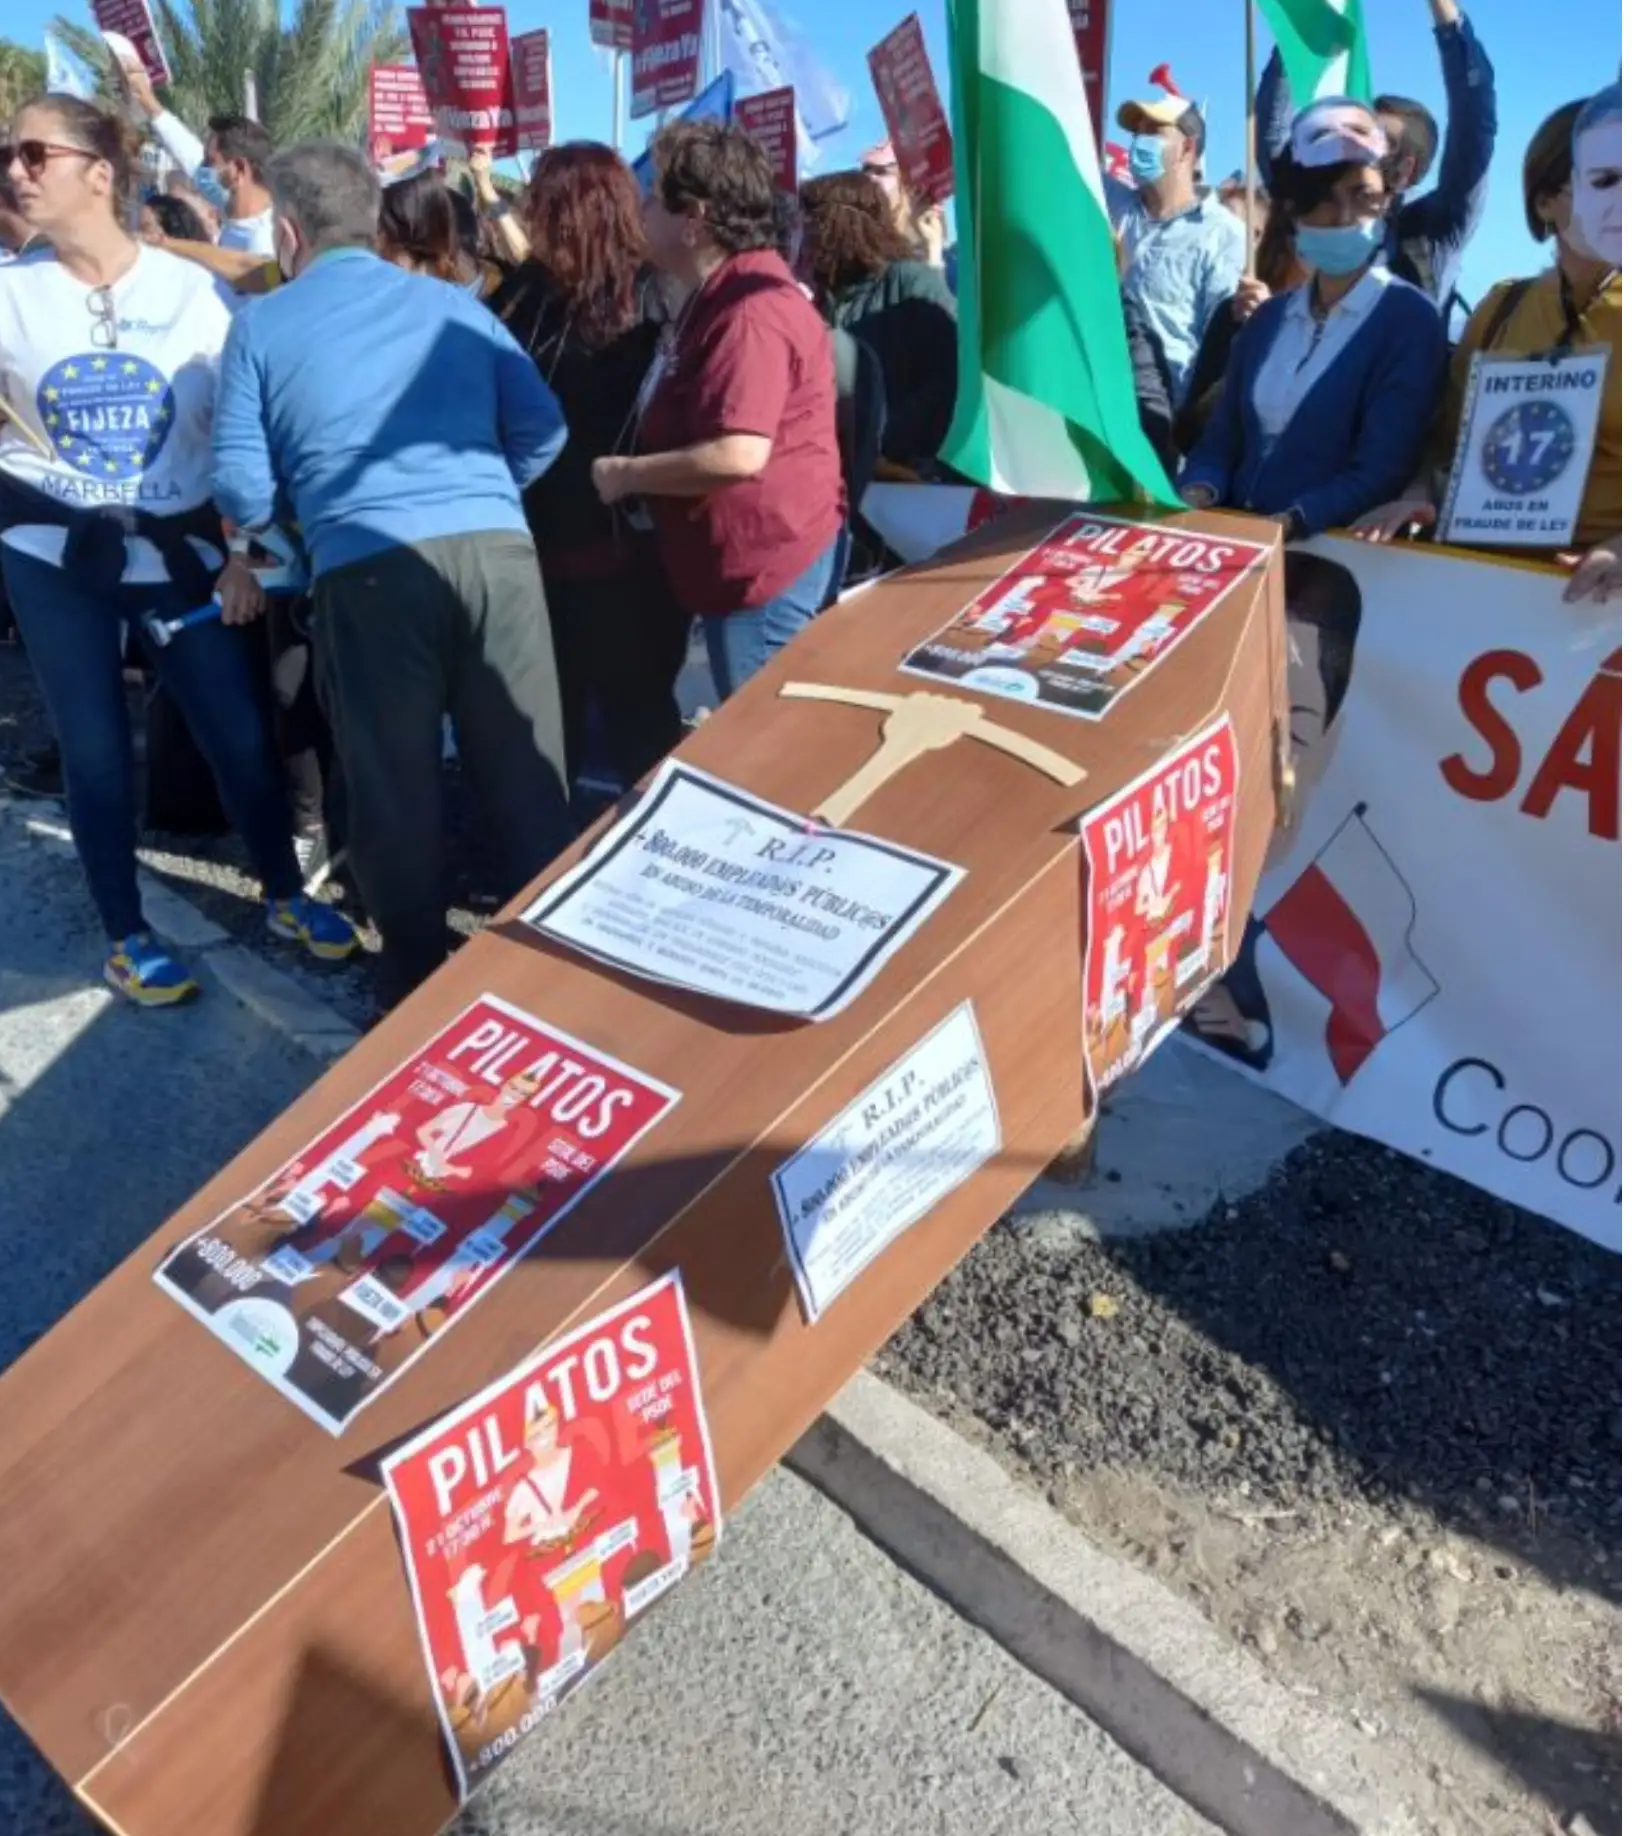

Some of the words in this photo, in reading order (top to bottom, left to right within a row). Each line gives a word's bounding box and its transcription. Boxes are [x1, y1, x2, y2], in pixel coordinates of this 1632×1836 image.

[1484, 369, 1597, 394] INTERINO
[67, 404, 151, 432] FIJEZA
[1500, 429, 1556, 466] 17
[42, 475, 182, 502] MARBELLA
[1527, 500, 1549, 512] EN
[1455, 517, 1512, 530] FRAUDE
[1517, 518, 1537, 530] DE
[1539, 518, 1568, 532] LEY
[1065, 524, 1234, 573] PILATOS
[1103, 746, 1223, 874] PILATOS
[754, 836, 836, 874] R.I.P.
[445, 1018, 634, 1138] PILATOS
[860, 1069, 926, 1130] R.I.P.
[1433, 1056, 1621, 1205] Coo
[427, 1314, 660, 1518] PILATOS
